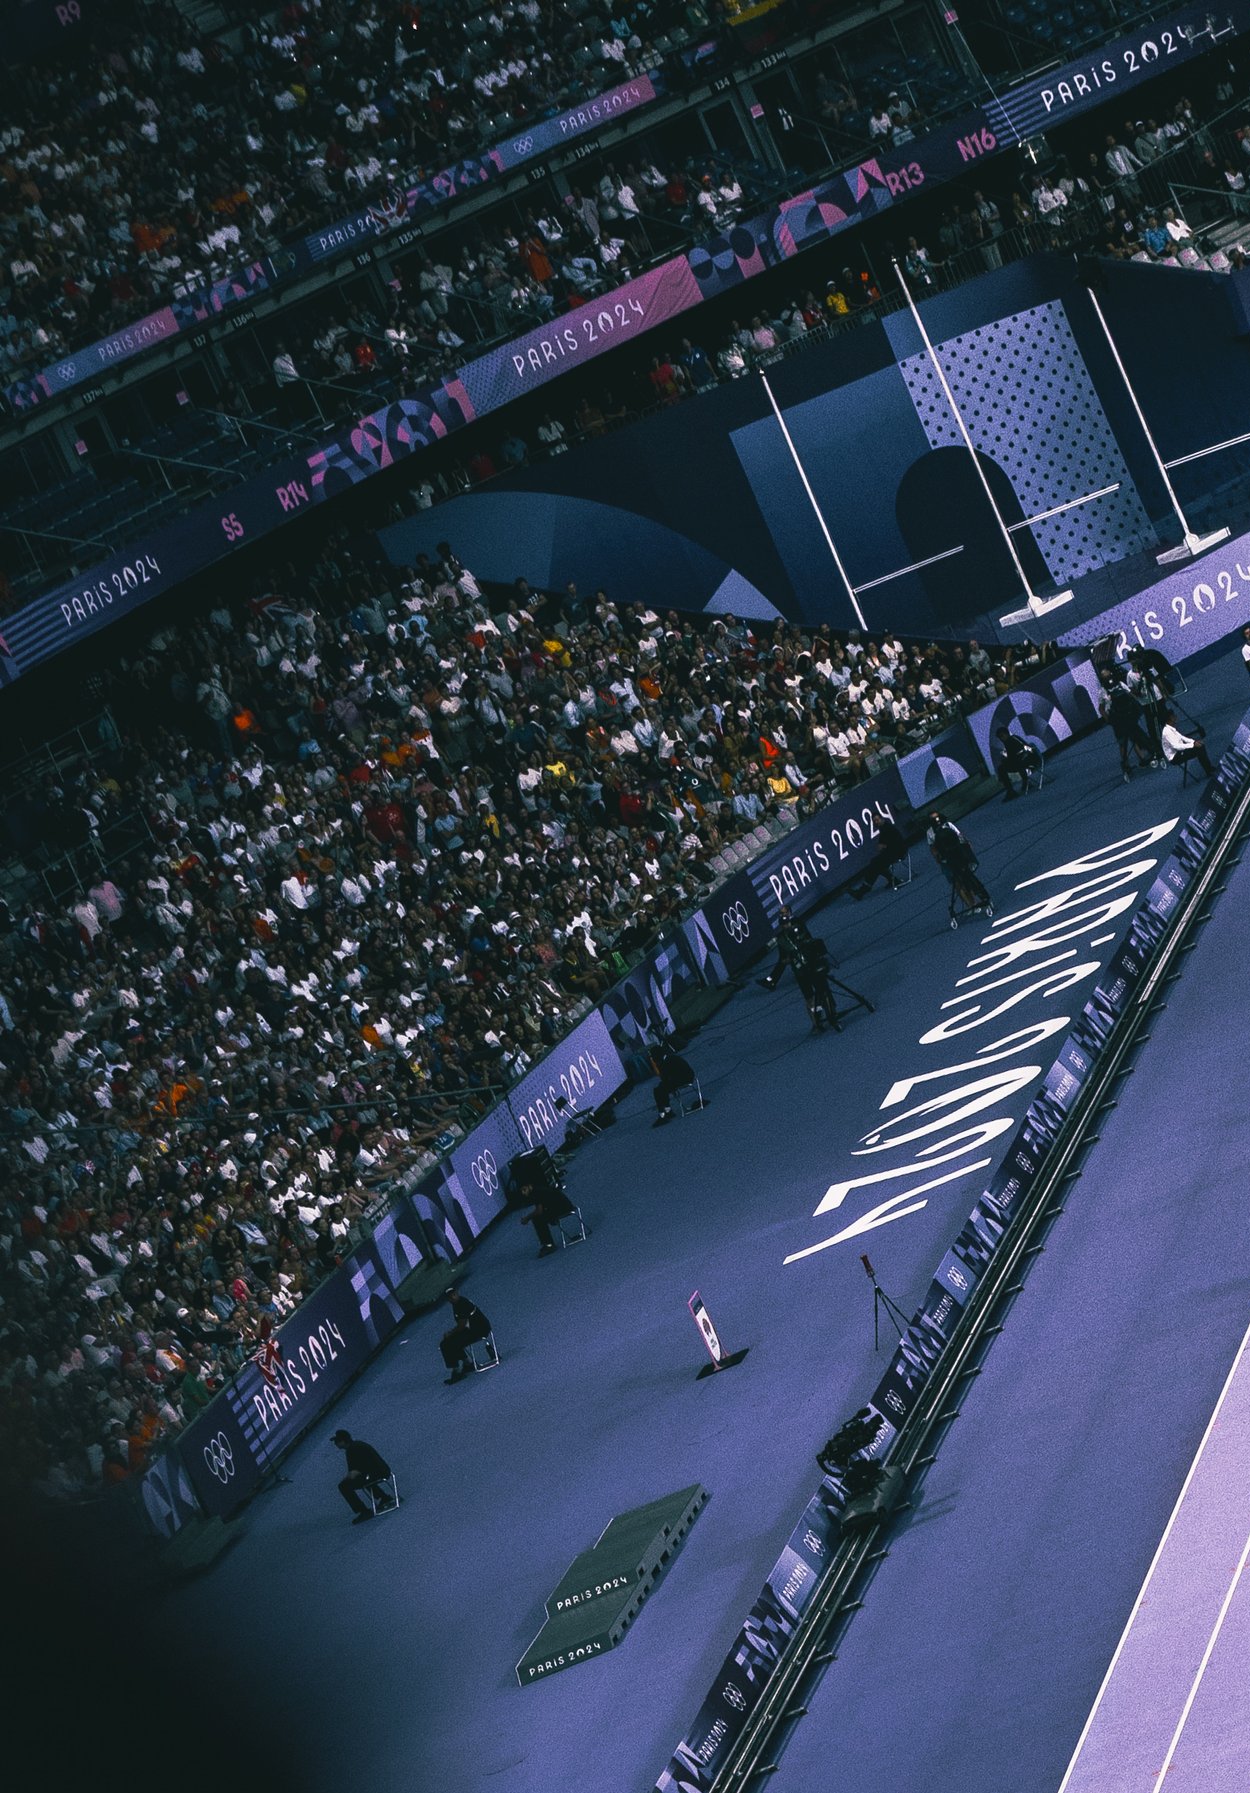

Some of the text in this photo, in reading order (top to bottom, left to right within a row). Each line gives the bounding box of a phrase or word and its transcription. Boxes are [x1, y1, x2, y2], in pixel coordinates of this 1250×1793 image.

[560, 86, 641, 134] PARIS 2024
[956, 126, 998, 162] N16
[884, 161, 926, 199] R13
[133, 319, 167, 344] 2024
[582, 298, 645, 342] 2024
[275, 480, 311, 512] R14
[221, 512, 245, 542] S5
[112, 555, 162, 597] 2024
[831, 800, 895, 860] 2024
[560, 1050, 603, 1107] 2024
[782, 1016, 1072, 1266] 2024
[298, 1318, 346, 1382] 2024
[556, 1576, 628, 1611] PARIS 2024
[529, 1642, 602, 1677] PARIS 2024
